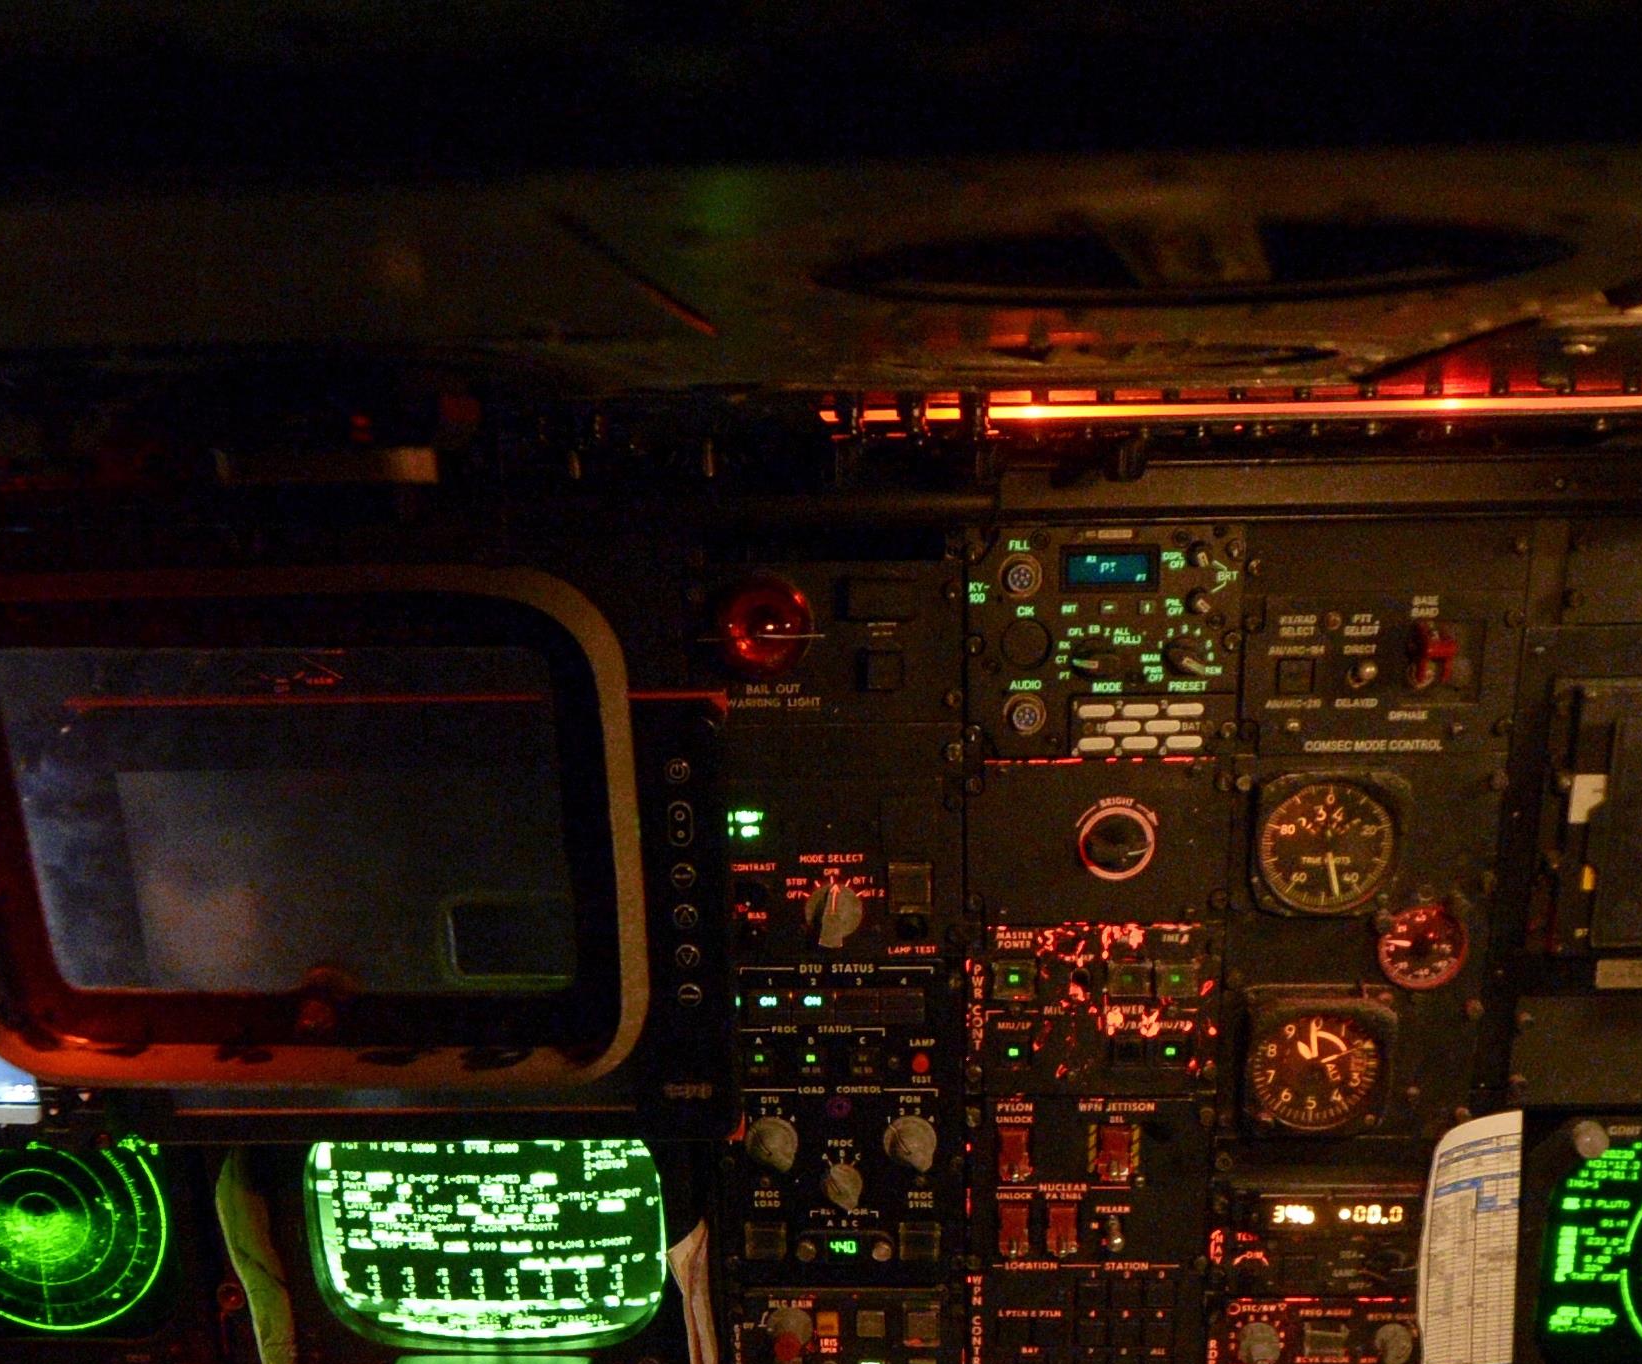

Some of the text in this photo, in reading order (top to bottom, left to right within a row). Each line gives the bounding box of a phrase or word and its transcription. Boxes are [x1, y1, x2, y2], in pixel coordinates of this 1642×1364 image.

[1009, 540, 1030, 550] FILL
[746, 683, 800, 694] BAIL OUT
[1010, 680, 1207, 692] AUDIO MODE PRESET
[787, 697, 821, 708] LIGHT
[1304, 739, 1443, 752] COMSEC MODE CONTROL
[1280, 824, 1295, 835] 80
[799, 854, 863, 863] MODE SELECT
[732, 863, 776, 871] CONTRAST
[996, 931, 1033, 940] MASTER
[998, 940, 1031, 949] POWER
[888, 946, 937, 955] LAMP TEST
[799, 963, 874, 974] DTU STATUS
[759, 995, 822, 1007] ON ON
[818, 1025, 852, 1034] STATUS
[1284, 1024, 1296, 1040] 9
[909, 1038, 936, 1047] LAMP
[1267, 1044, 1277, 1058] 8
[911, 1075, 932, 1084] TEST
[1266, 1069, 1276, 1084] 7
[797, 1085, 882, 1095] LOAD CONTROL
[1281, 1088, 1342, 1110] 6 5 4
[997, 1103, 1033, 1112] PYLON
[1106, 1103, 1155, 1112] JETTISON
[995, 1116, 1033, 1124] UNLOCK
[1039, 1183, 1087, 1193] NUCLEAR
[754, 1190, 934, 1200] PROC PROC
[995, 1192, 1033, 1200] UNLOCK
[754, 1200, 781, 1208] LOAD
[829, 1240, 857, 1254] 440
[1005, 1262, 1149, 1271] LOCATION STATION
